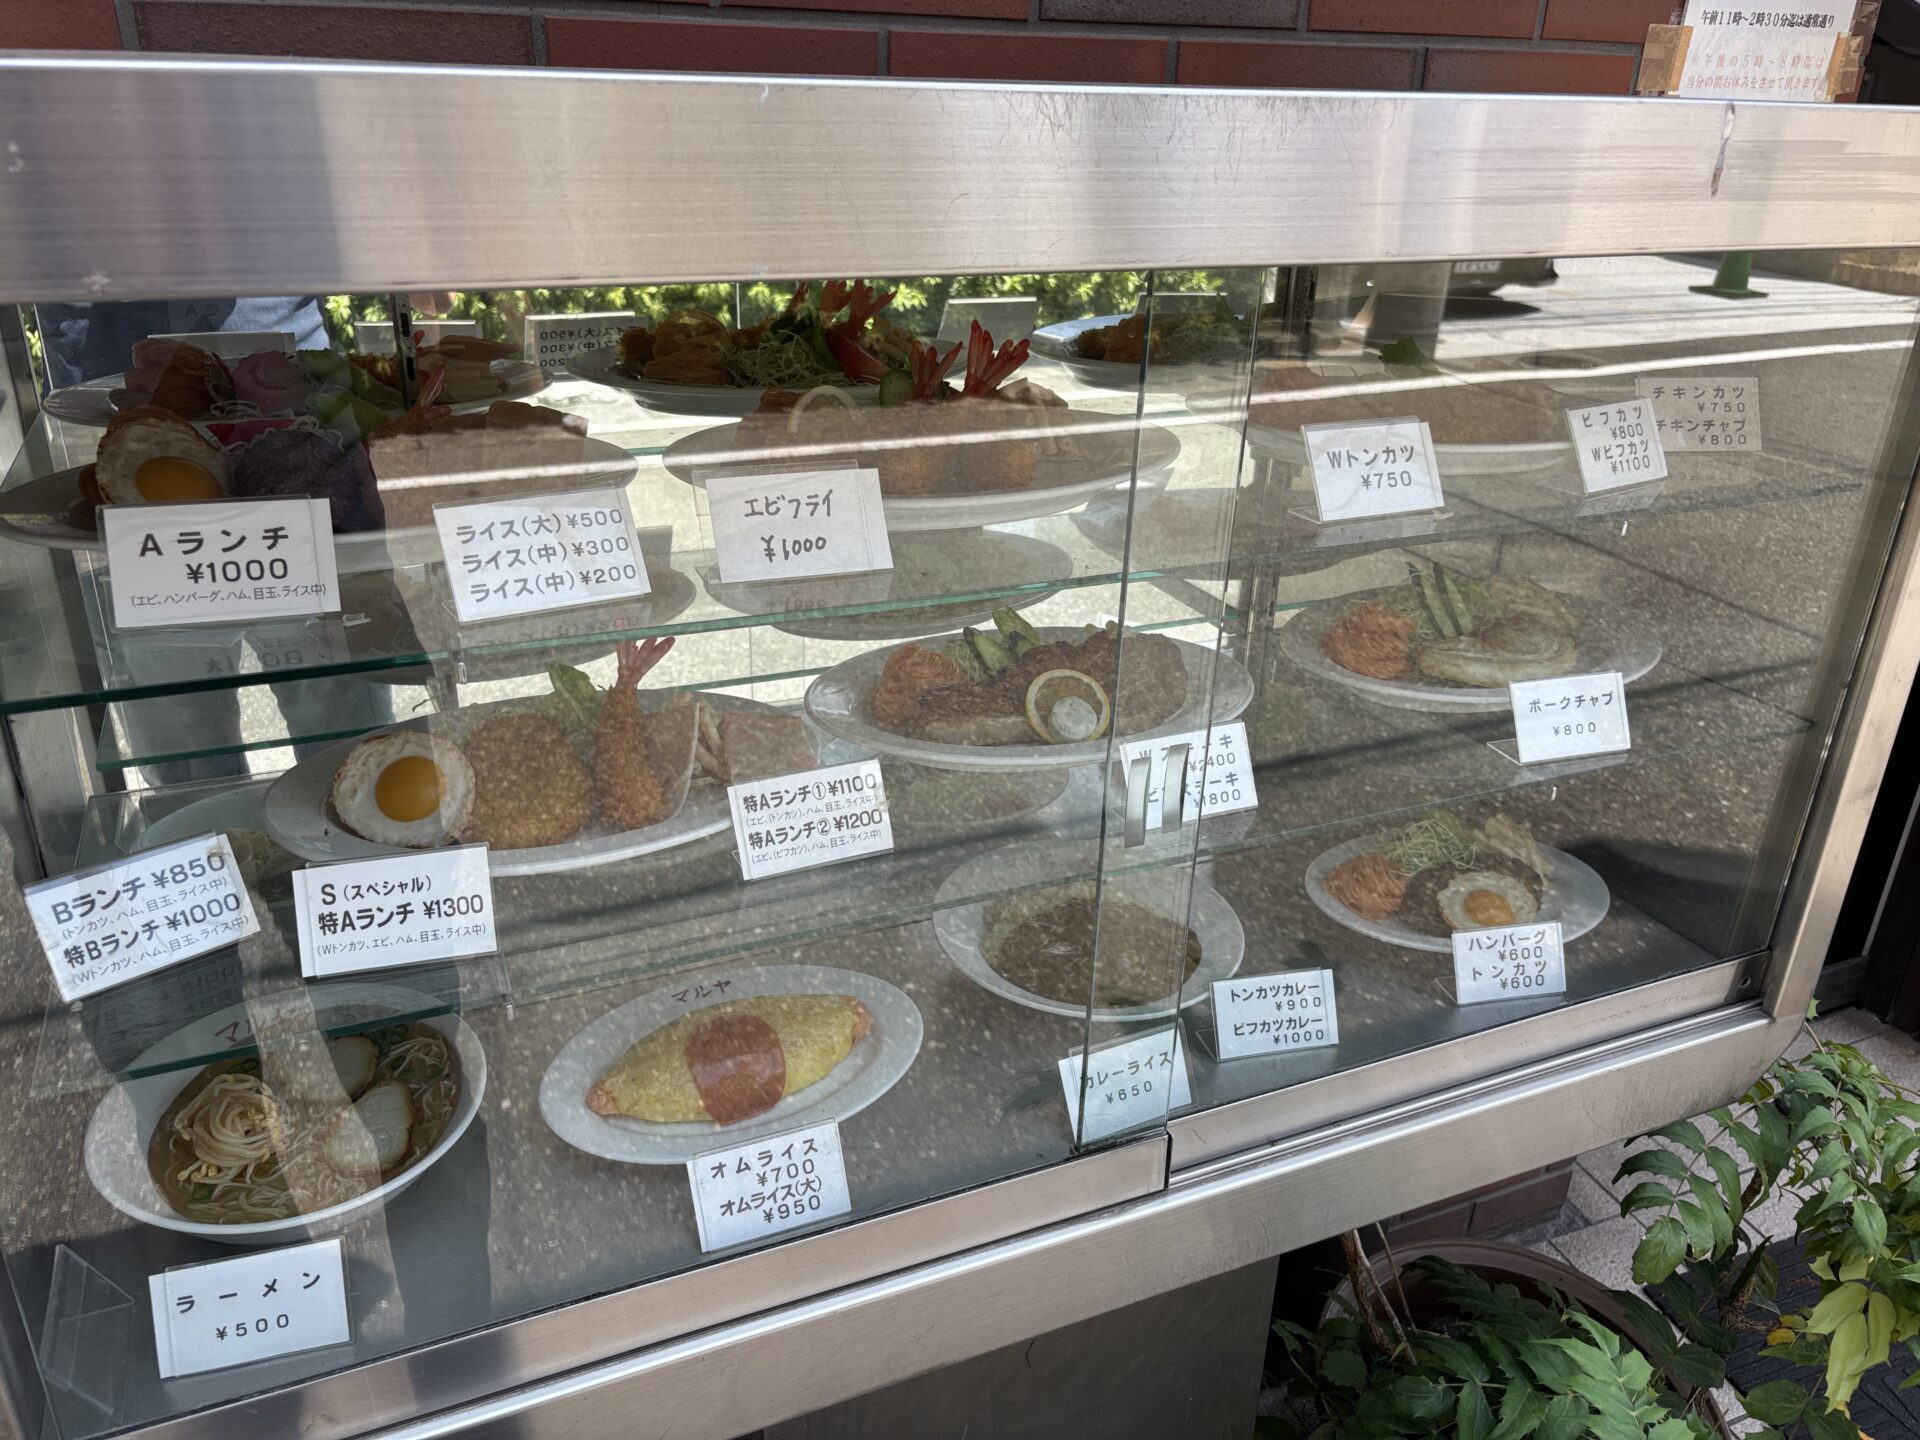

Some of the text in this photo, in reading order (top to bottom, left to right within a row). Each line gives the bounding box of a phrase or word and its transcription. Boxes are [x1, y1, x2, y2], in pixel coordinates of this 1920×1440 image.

[1652, 385, 1745, 400] チキンカツ
[1582, 405, 1642, 428] ビフカツ
[1697, 402, 1746, 413] ¥750
[1610, 423, 1644, 441] ¥800
[1698, 434, 1747, 446] ¥800
[1326, 445, 1414, 469] Wトンカツ
[1592, 439, 1649, 463] Wビフカツ
[1610, 455, 1651, 475] ¥1100
[1360, 470, 1412, 490] ¥750
[743, 488, 833, 519] エビフライ
[566, 508, 623, 529] ¥500
[139, 526, 289, 557] Aランチ
[571, 536, 629, 557] ¥300
[760, 535, 827, 563] ¥1000
[185, 557, 288, 584] ¥1000
[579, 564, 637, 586] ¥200
[1553, 722, 1596, 736] ¥800
[834, 808, 883, 832] ¥1200
[51, 853, 226, 925] Bランチ ¥850
[318, 894, 484, 936] 特Aランチ ¥1300
[63, 892, 241, 969] 特Bランチ ¥1000
[1469, 929, 1546, 951] ハンバーグ
[1498, 946, 1543, 962] ¥600
[1472, 960, 1547, 981] トンカツ
[1500, 974, 1545, 990] ¥600
[670, 979, 732, 1002] マルヤ
[1231, 982, 1320, 1003] トンカツカレー
[1275, 996, 1322, 1012] ¥900
[1234, 1016, 1323, 1036] ビフカツカレー
[1273, 1029, 1324, 1045] ¥1000
[1105, 1080, 1153, 1104] ¥650
[710, 1138, 818, 1179] オムライス
[756, 1158, 815, 1187] ¥700
[720, 1175, 822, 1216] オムライス(大)
[762, 1195, 821, 1224] ¥950
[176, 1272, 320, 1314] ラーメン
[215, 1313, 290, 1340] ¥500
